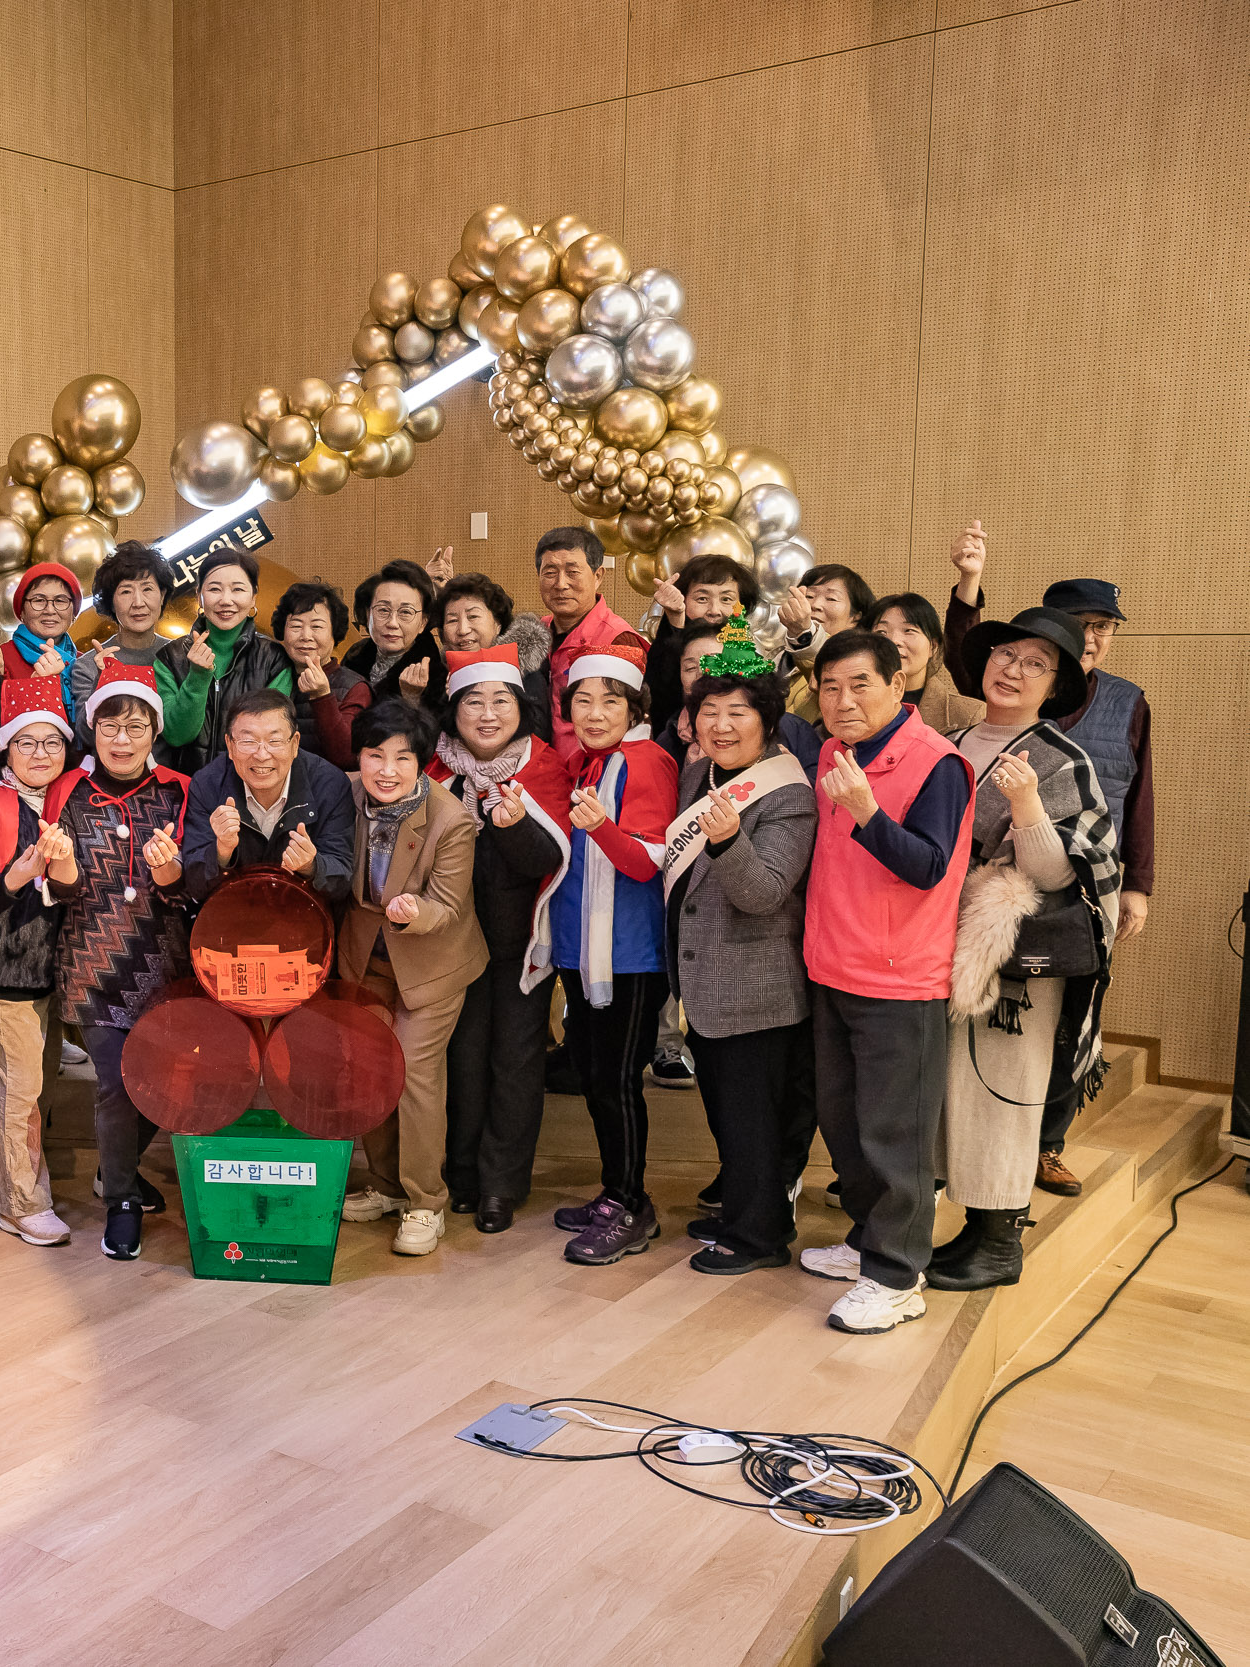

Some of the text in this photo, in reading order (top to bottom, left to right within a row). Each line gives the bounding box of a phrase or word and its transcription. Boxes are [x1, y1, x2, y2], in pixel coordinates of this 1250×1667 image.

[233, 517, 266, 549] 날
[672, 811, 705, 852] 026
[236, 962, 248, 996] 따뜻한
[207, 1162, 313, 1181] 감사합니다!
